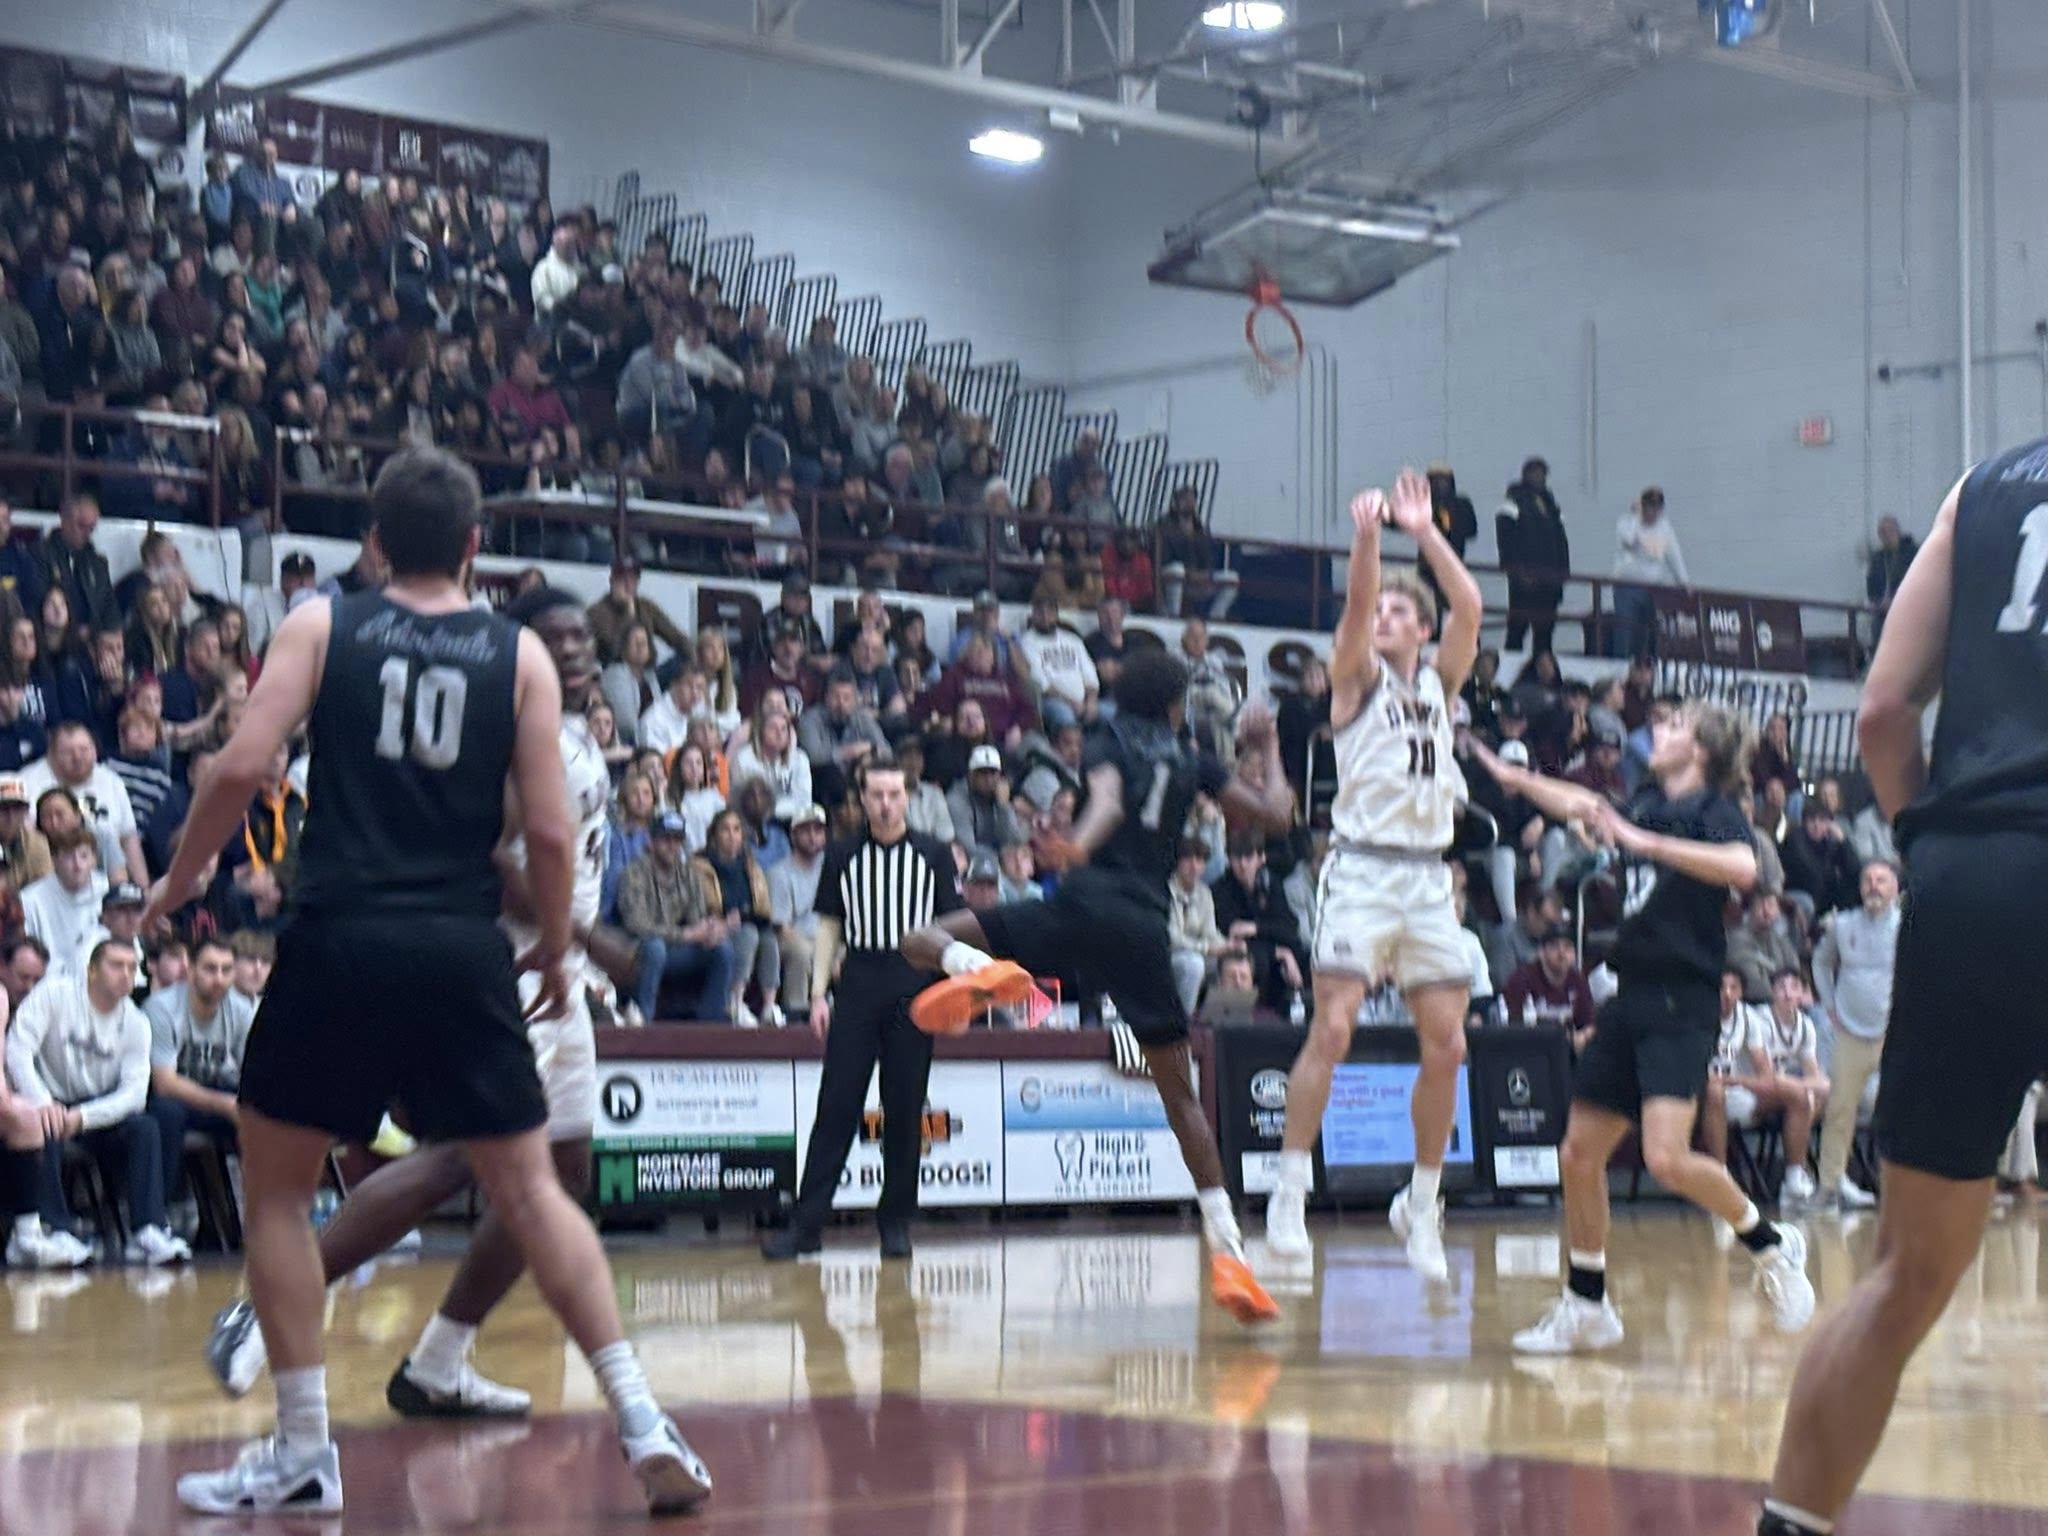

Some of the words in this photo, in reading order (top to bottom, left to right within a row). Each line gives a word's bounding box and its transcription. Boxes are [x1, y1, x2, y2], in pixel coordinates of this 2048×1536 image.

[374, 655, 468, 770] 10
[1094, 1131, 1132, 1158] High
[637, 1152, 721, 1171] MORTGAGE
[1089, 1156, 1151, 1179] Pickett
[637, 1169, 721, 1192] INVESTORS
[723, 1167, 775, 1190] GROUP
